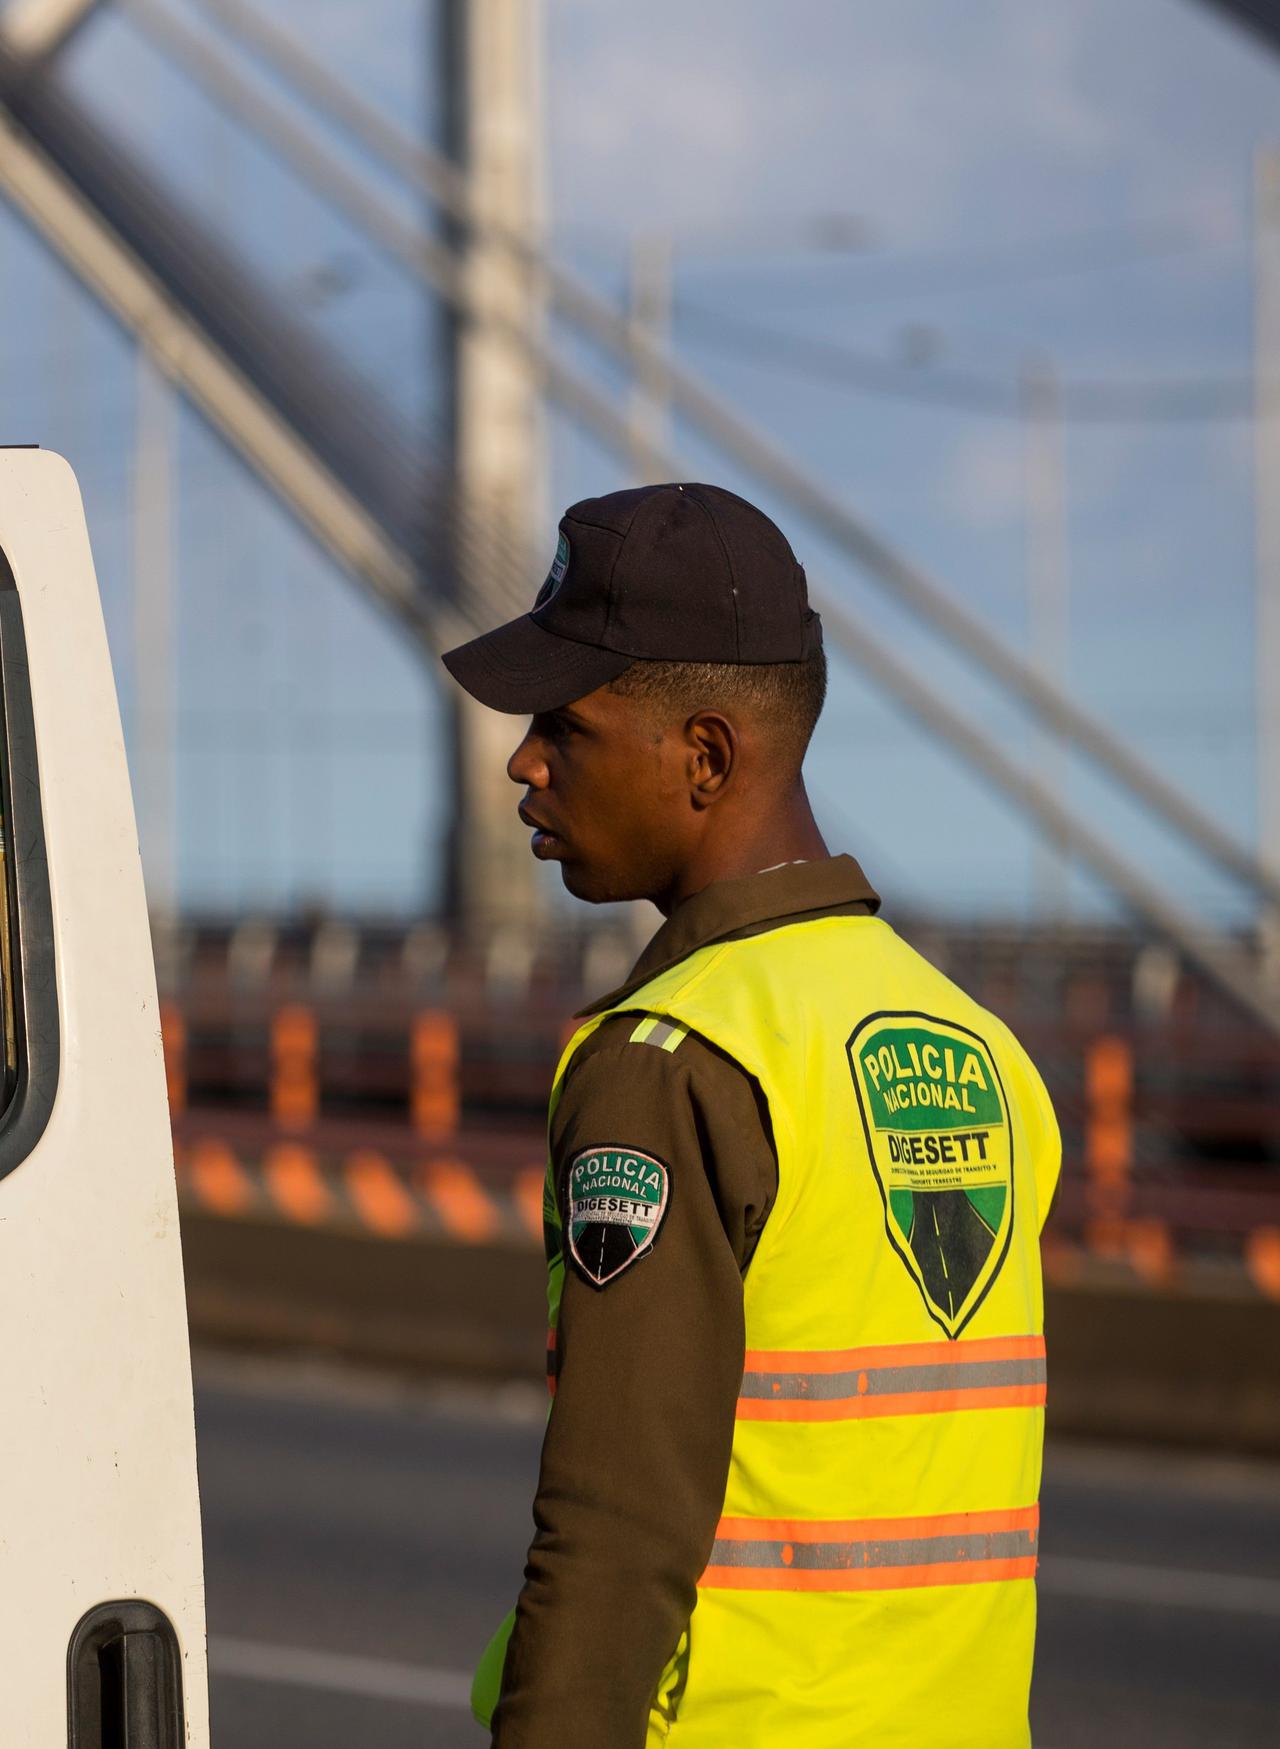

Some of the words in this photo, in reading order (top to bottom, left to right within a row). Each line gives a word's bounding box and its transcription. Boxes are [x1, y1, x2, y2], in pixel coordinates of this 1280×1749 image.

[864, 1042, 988, 1091] POLICIA
[883, 1082, 976, 1115] NACIONAL
[887, 1131, 989, 1165] DIGESETT
[575, 1156, 660, 1190] POLICIA
[582, 1175, 647, 1198] NACIONAL
[577, 1198, 653, 1217] DIGESETT
